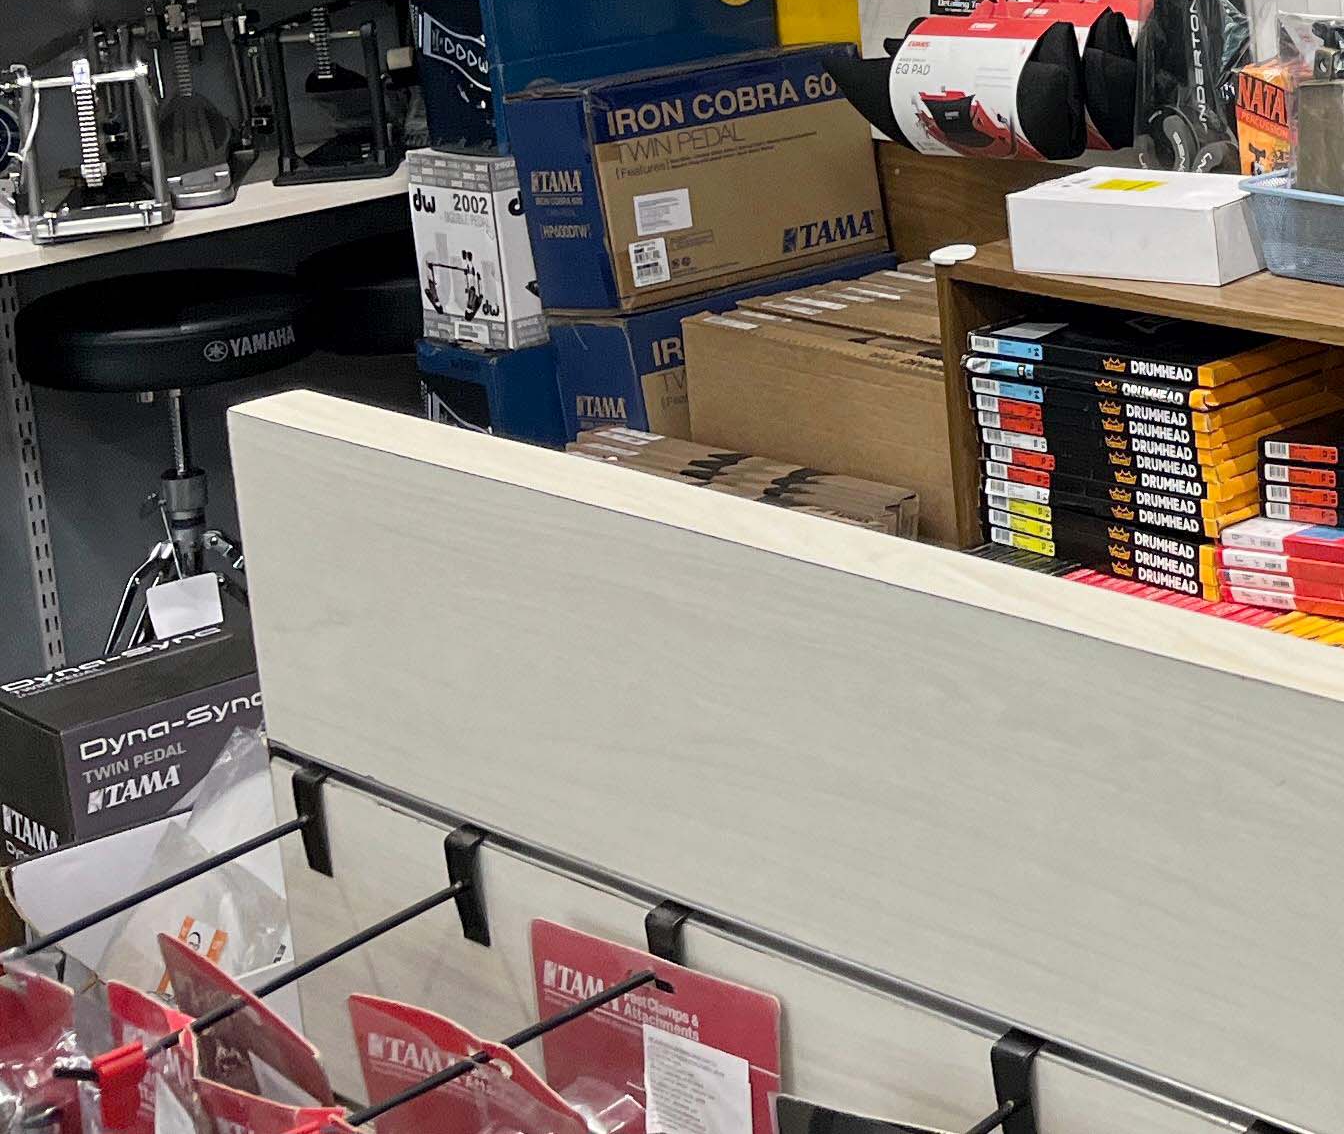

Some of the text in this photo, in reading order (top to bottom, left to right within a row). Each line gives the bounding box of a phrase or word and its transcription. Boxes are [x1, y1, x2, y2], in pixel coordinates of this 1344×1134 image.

[895, 63, 930, 76] EQ PAD
[606, 98, 684, 136] IRON
[693, 79, 798, 120] COBRA
[1240, 111, 1290, 140] PERCUSSION
[617, 138, 673, 164] TWIN
[677, 123, 745, 152] PEDAL
[542, 170, 583, 193] TAMA
[413, 188, 488, 215] dw 2002
[800, 209, 875, 250] TAMA
[482, 300, 500, 316] dw
[229, 324, 296, 358] YAMAHA
[1130, 361, 1193, 382] DRUMHEAD
[587, 396, 626, 419] TAMA
[1126, 404, 1187, 426] DRUMHEAD
[1129, 421, 1190, 443] DRUMHEAD
[1131, 438, 1192, 461] DRUMHEAD
[1136, 455, 1197, 478] DRUMHEAD
[1141, 474, 1202, 497] DRUMHEAD
[1139, 510, 1199, 533] DRUMHEAD
[1134, 531, 1195, 559] DRUMHEAD
[1138, 567, 1198, 594] DRUMHEAD
[1, 626, 221, 693] Dyna-Sync
[80, 691, 264, 760] Dyna-Sync
[83, 742, 186, 784] TWIN PEDAL
[105, 764, 181, 808] TAMA
[14, 811, 58, 851] TAMA
[625, 993, 689, 1026] Fast Clamps
[624, 1006, 698, 1041] Attachments
